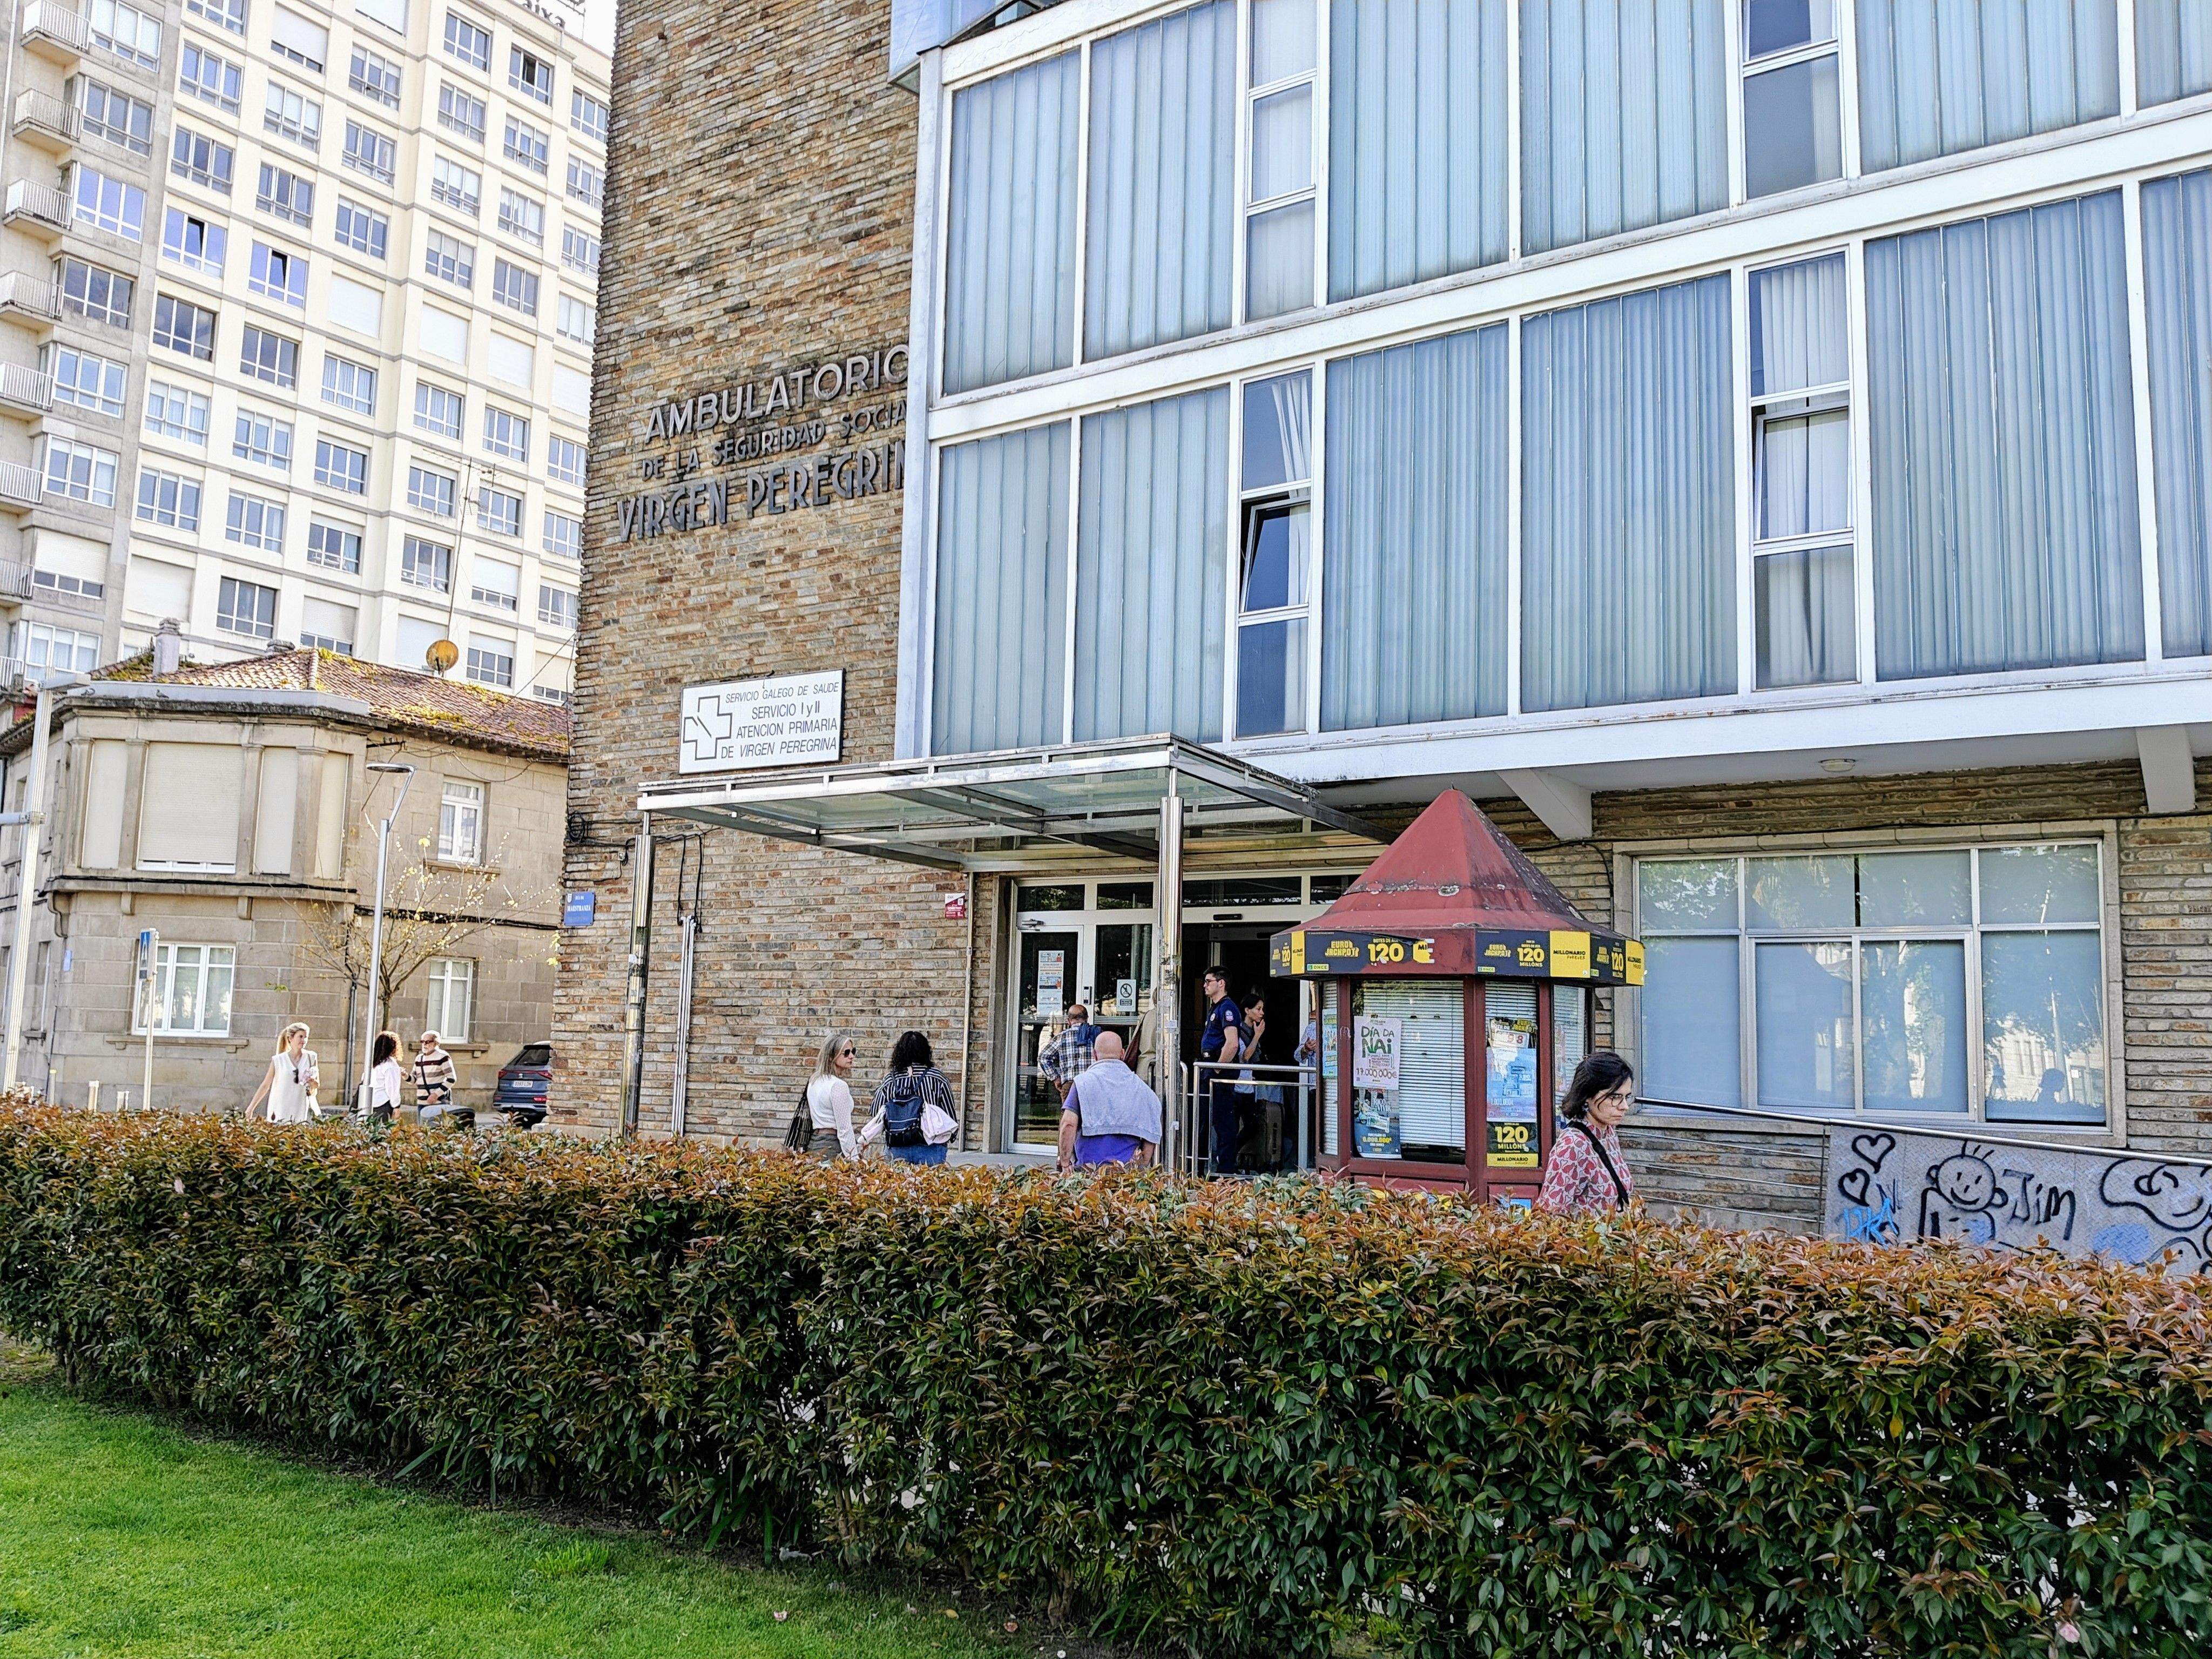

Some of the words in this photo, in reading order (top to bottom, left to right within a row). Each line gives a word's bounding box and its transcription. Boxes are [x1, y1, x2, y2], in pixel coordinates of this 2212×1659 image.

[645, 344, 909, 443] AMBULATORIO
[642, 458, 665, 481] DE
[676, 448, 700, 475] LA
[711, 419, 827, 466] SEGURIDAD
[839, 400, 908, 438] SOCIA
[617, 478, 728, 542] VIRGEN
[725, 690, 759, 704] SERVICIO
[763, 686, 794, 700] GALEGO
[797, 685, 808, 696] DE
[813, 682, 839, 694] SAUDE
[752, 703, 796, 720] SERVICIO
[806, 705, 813, 718] y
[736, 722, 784, 739] ATENCION
[788, 717, 838, 734] PRIMARIA
[721, 745, 734, 759] DE
[740, 741, 775, 757] VIRGEN
[780, 737, 837, 754] PEREGRINA
[1282, 949, 1291, 962] 120
[1325, 947, 1360, 957] JACKPOT
[1367, 942, 1404, 962] 120
[1517, 947, 1545, 962] 120
[1611, 952, 1624, 972] 120
[1383, 1028, 1394, 1037] DA
[1494, 1125, 1528, 1143] 120
